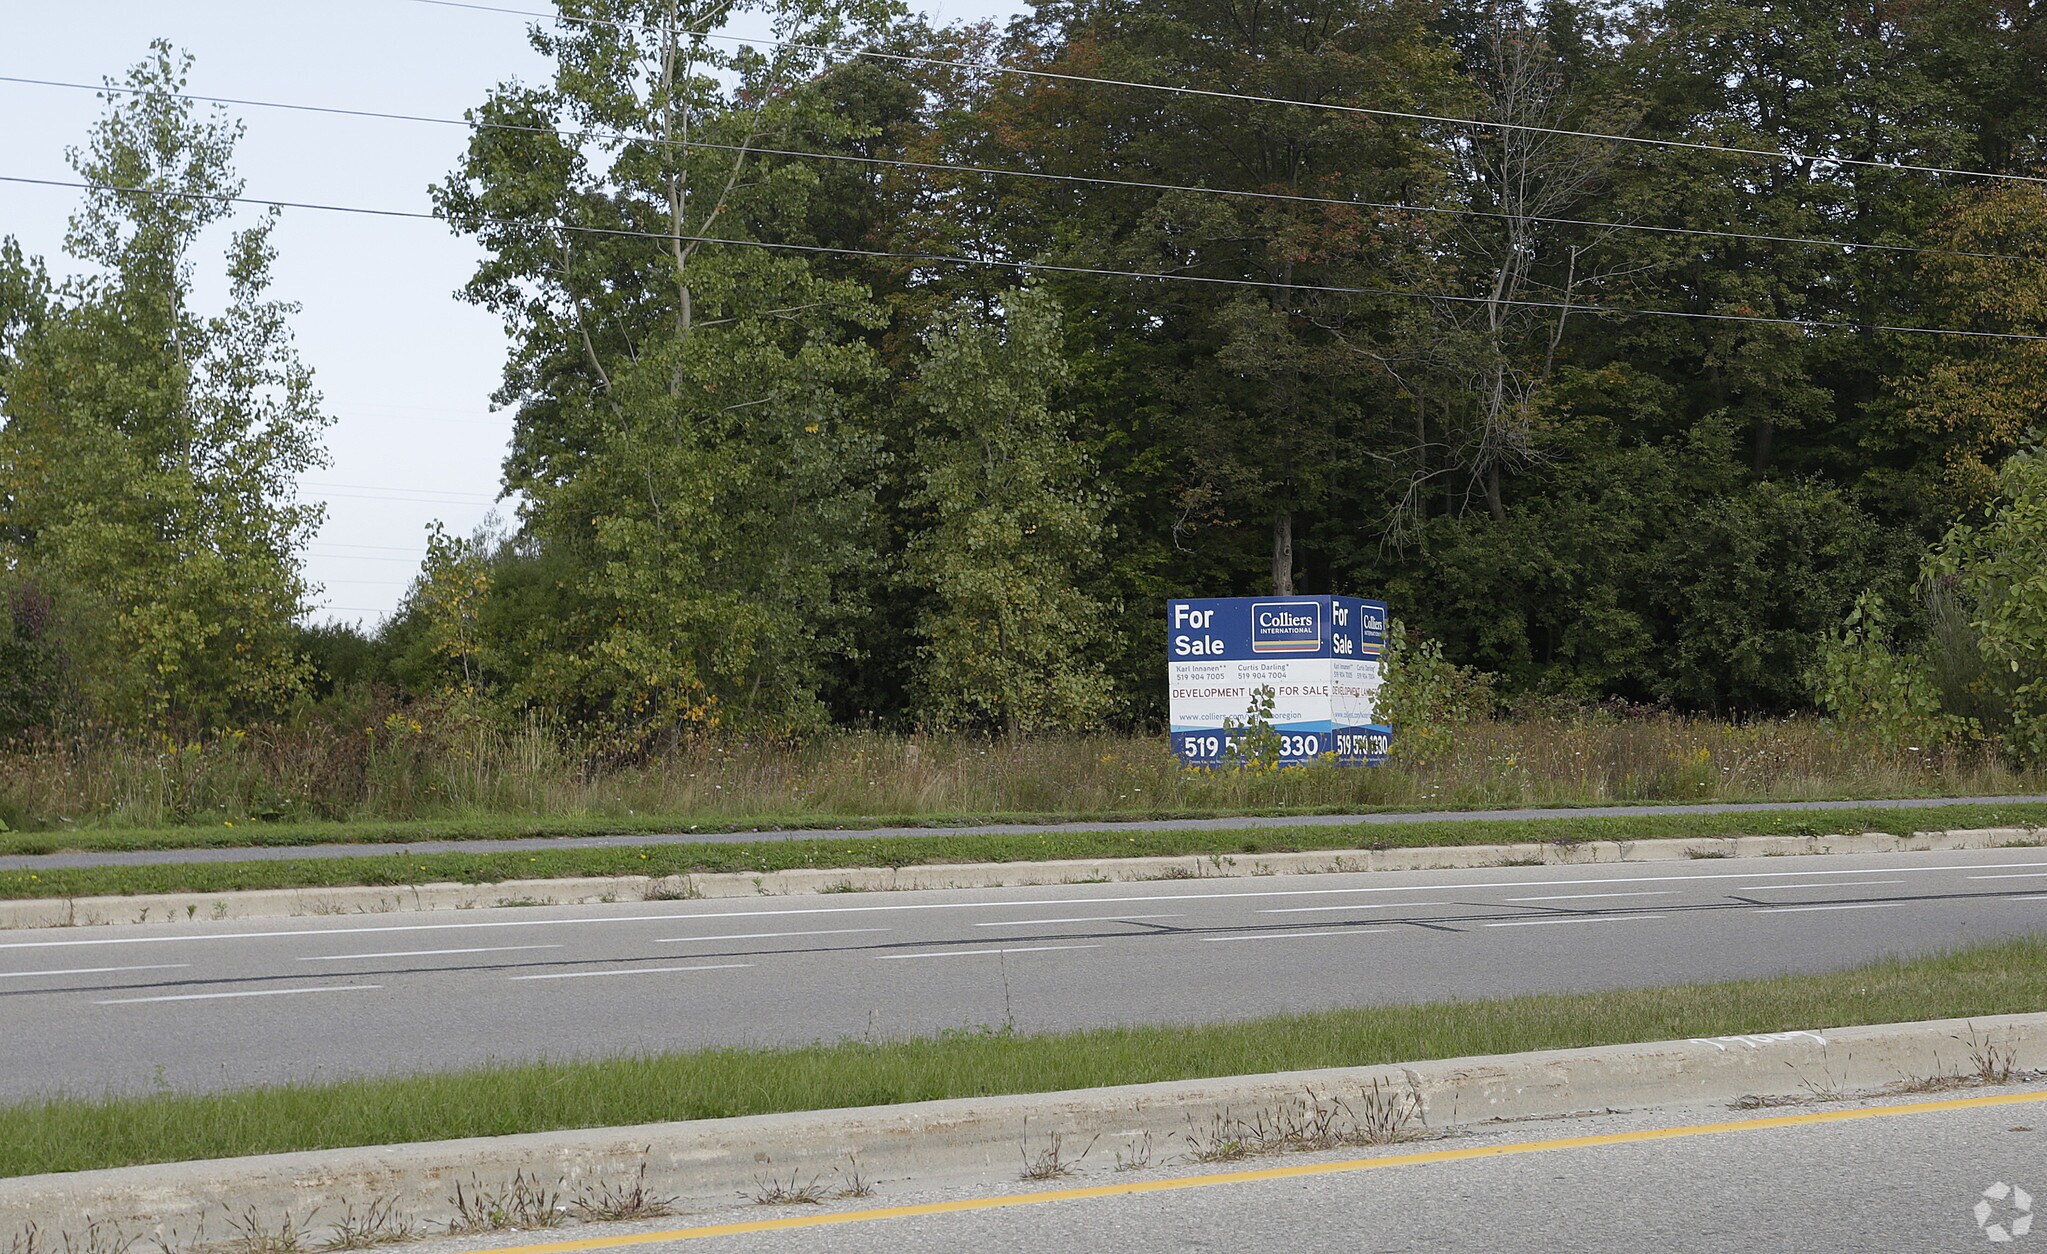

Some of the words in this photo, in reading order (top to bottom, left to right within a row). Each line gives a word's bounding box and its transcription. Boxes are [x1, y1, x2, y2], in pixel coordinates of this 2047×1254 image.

[1174, 604, 1214, 629] For
[1259, 611, 1313, 627] Colliers
[1332, 601, 1349, 627] For
[1363, 614, 1383, 631] Colliers
[1260, 627, 1313, 635] INTERNATIONAL
[1174, 634, 1225, 656] Sale
[1333, 633, 1353, 655] Sale
[1176, 673, 1189, 681] 519
[1172, 687, 1245, 698] DEVELOPMENT
[1279, 686, 1299, 696] FOR
[1301, 685, 1329, 696] SALE
[1184, 736, 1219, 757] 519
[1337, 734, 1351, 755] 519
